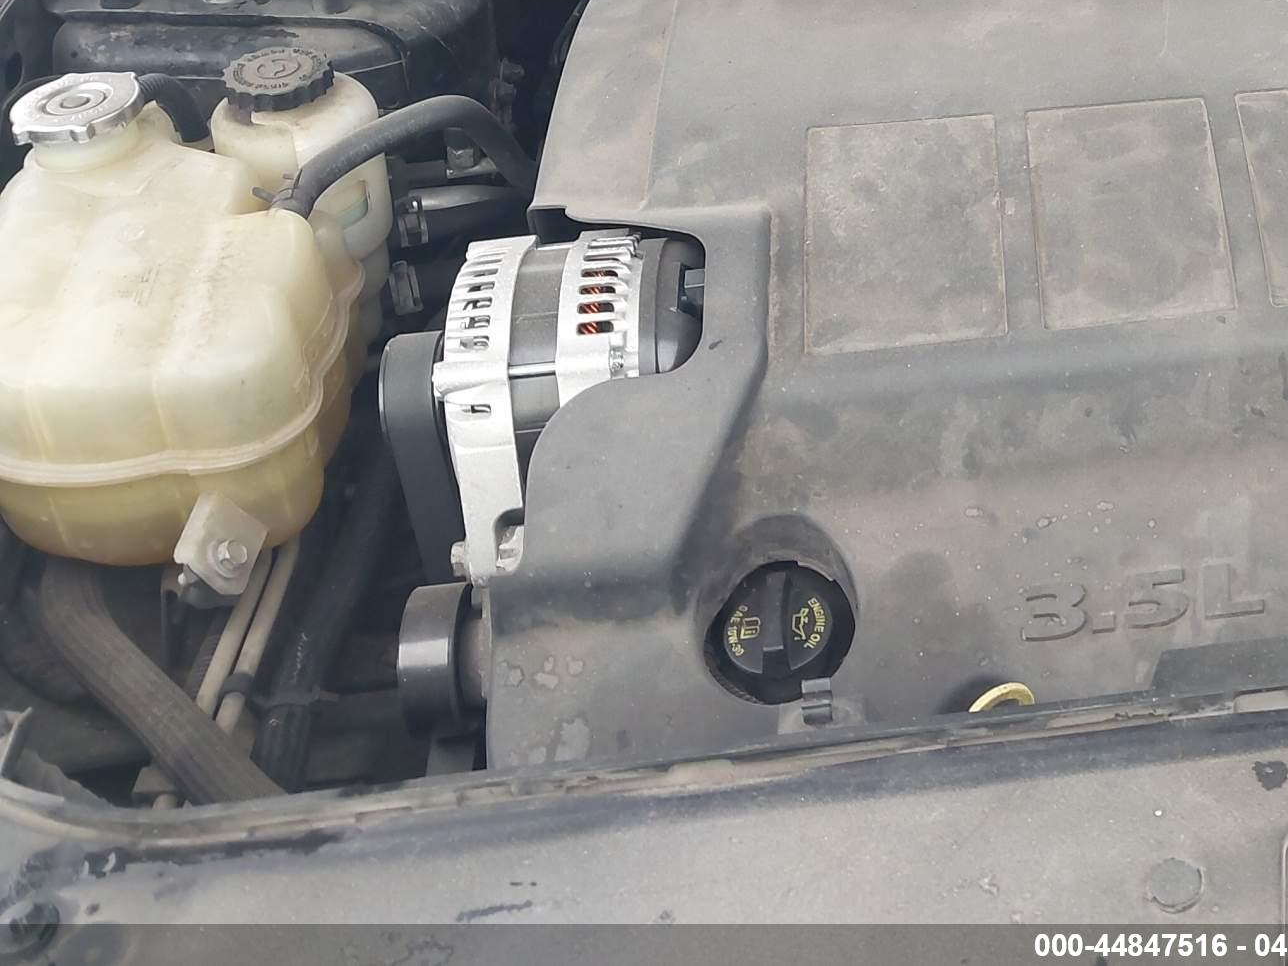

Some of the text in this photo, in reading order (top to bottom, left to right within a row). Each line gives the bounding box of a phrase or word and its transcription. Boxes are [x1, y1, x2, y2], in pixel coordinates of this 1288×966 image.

[803, 597, 826, 650] ENGINE OIL
[1021, 563, 1265, 642] 3.5L
